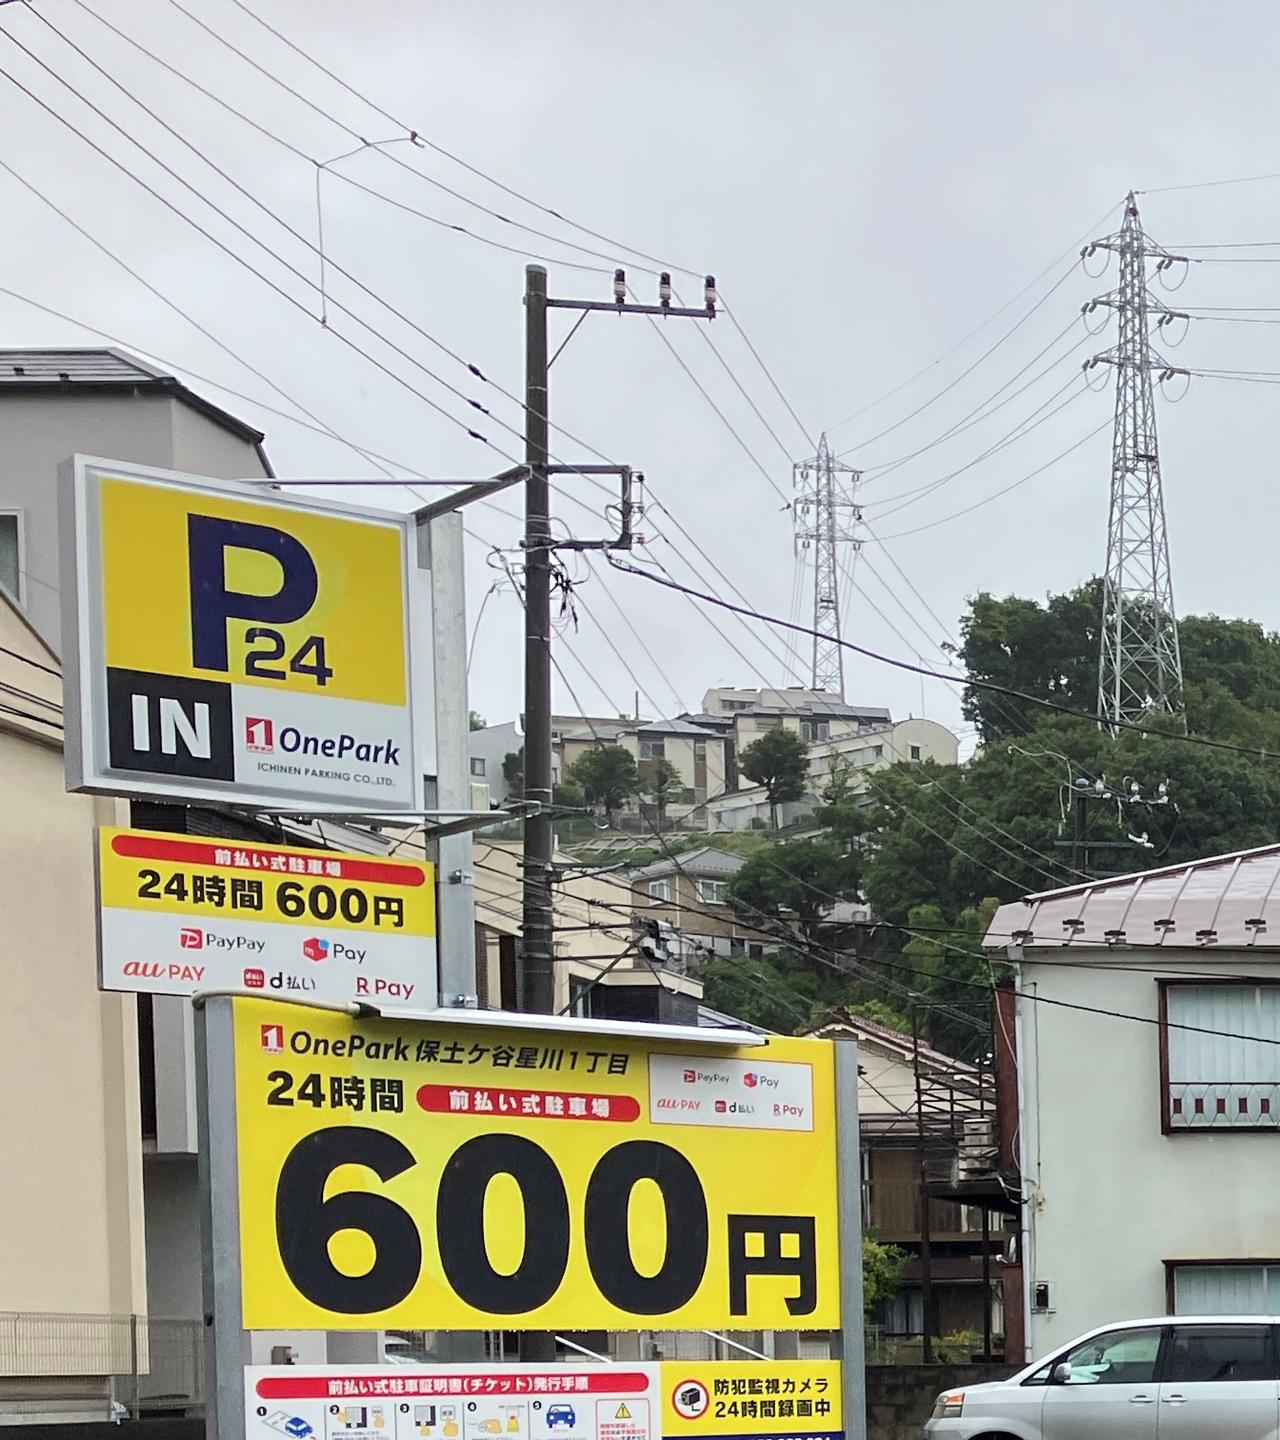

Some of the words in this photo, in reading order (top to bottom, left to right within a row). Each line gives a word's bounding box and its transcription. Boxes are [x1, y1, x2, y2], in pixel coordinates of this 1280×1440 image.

[186, 512, 319, 673] P
[244, 627, 334, 687] 24
[130, 693, 213, 760] IN
[279, 726, 401, 767] OnePark
[257, 761, 302, 778] ICHINEN
[304, 767, 351, 783] PARKING
[213, 848, 342, 877] 前払い式駐車場
[137, 869, 264, 911] 24時間
[275, 881, 405, 928] 600円
[205, 933, 265, 953] PayPay
[333, 943, 367, 964] Pay
[123, 961, 166, 979] au
[168, 965, 206, 982] PAY
[375, 979, 415, 1000] Pay
[290, 1030, 411, 1063] OnePark
[415, 1038, 630, 1076] 保土ケ谷星川1丁目
[267, 1070, 405, 1114] 24時間
[449, 1089, 612, 1118] 前払い式駐車場
[697, 1073, 730, 1085] PayPay
[760, 1076, 780, 1090] Pay
[657, 1098, 680, 1109] au
[681, 1099, 702, 1111] PAY
[783, 1105, 805, 1117] Pay
[275, 1125, 818, 1318] 600円
[327, 1375, 590, 1396] 前払い式駐車証明書(チケット)発行手順
[713, 1378, 829, 1396] 防犯監視カメラ
[715, 1399, 831, 1419] 24時間録画中
